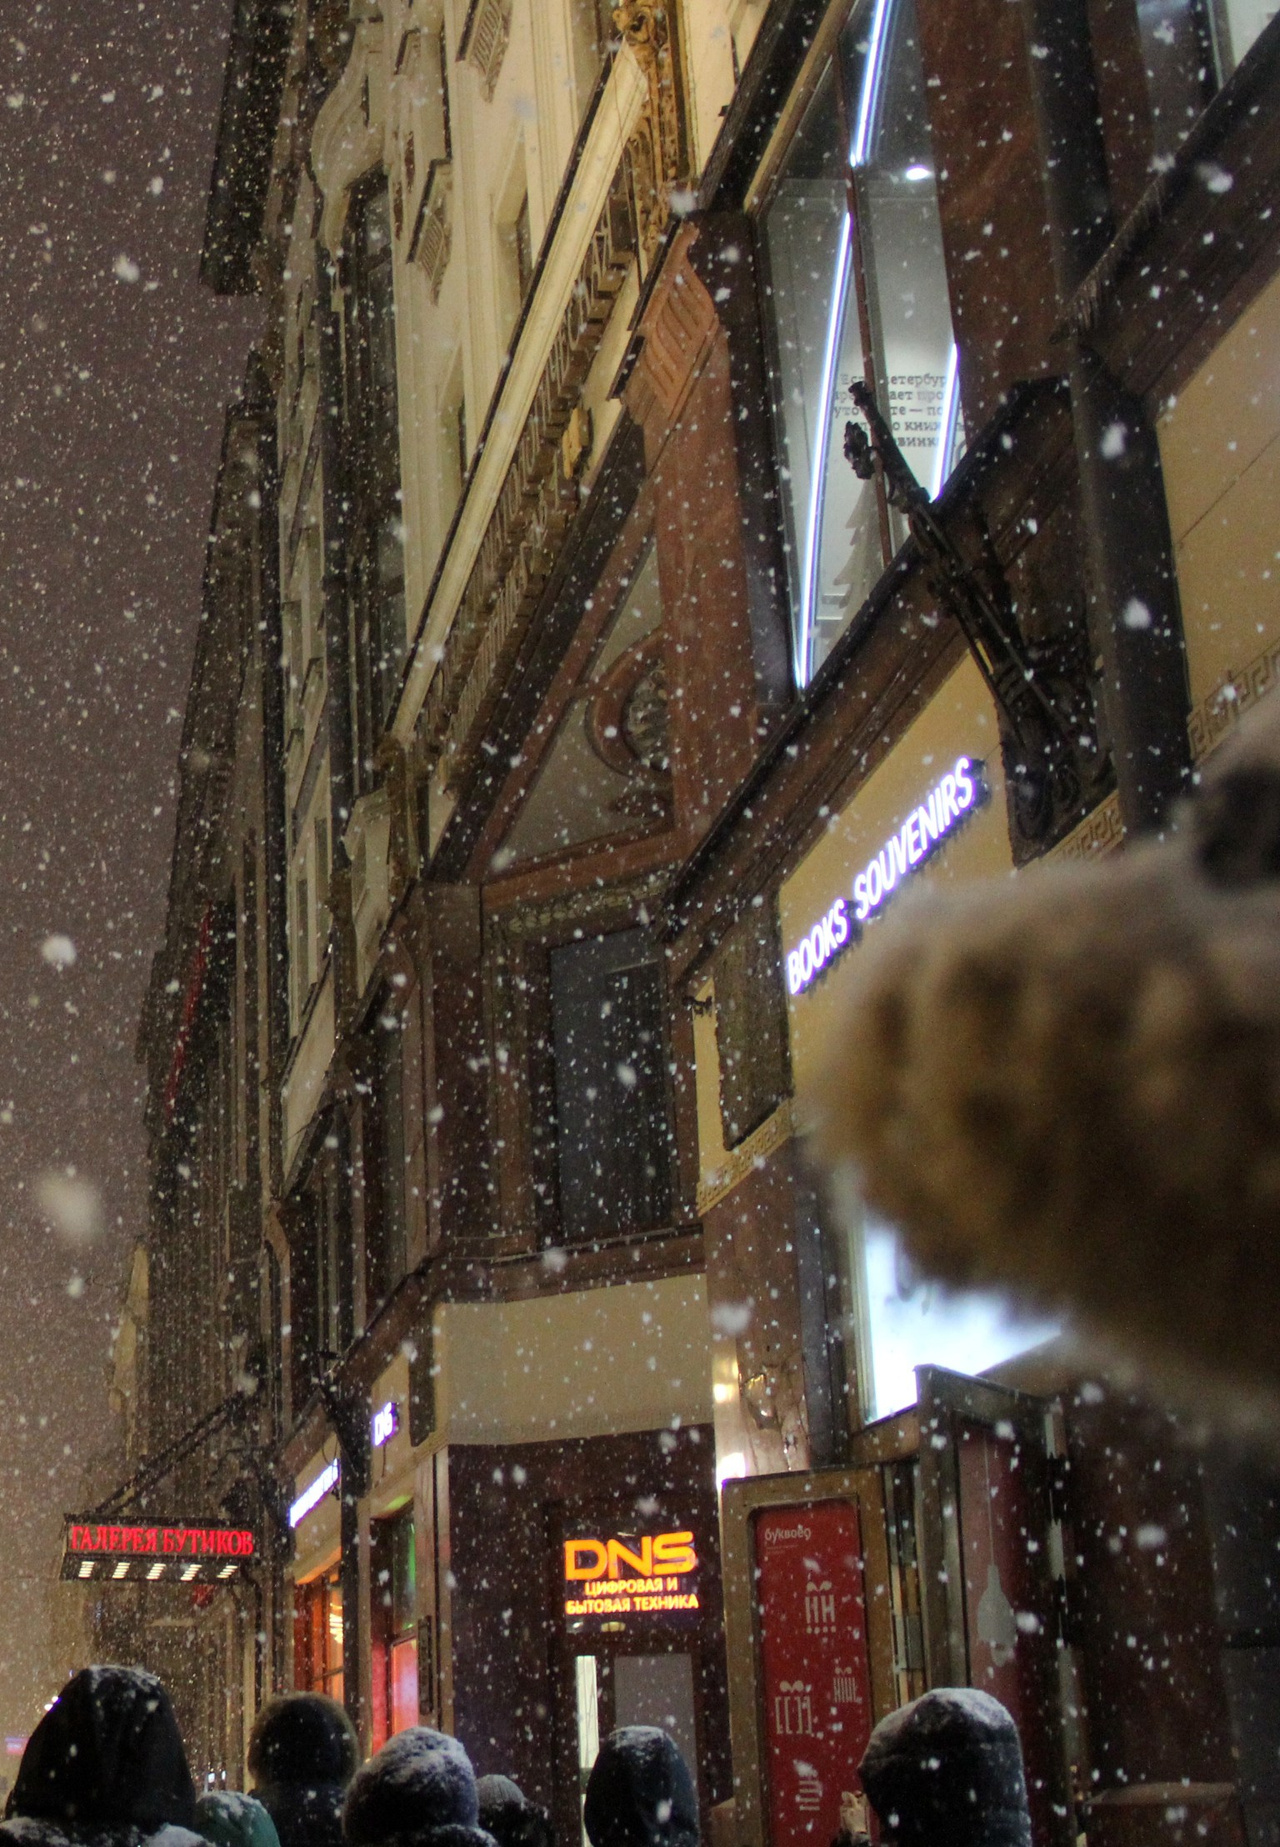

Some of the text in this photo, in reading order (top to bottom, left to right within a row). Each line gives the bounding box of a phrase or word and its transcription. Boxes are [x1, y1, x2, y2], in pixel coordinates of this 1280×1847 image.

[787, 757, 973, 995] BOOKS SOUVENIRS
[71, 1526, 254, 1555] ГАЛЕРЕЯ БУТИКОВ
[565, 1531, 697, 1580] DNS
[584, 1577, 678, 1597] ЦИФРОВАЯ И
[565, 1594, 700, 1615] БЫТОВАЯ ТЕХНИКА
